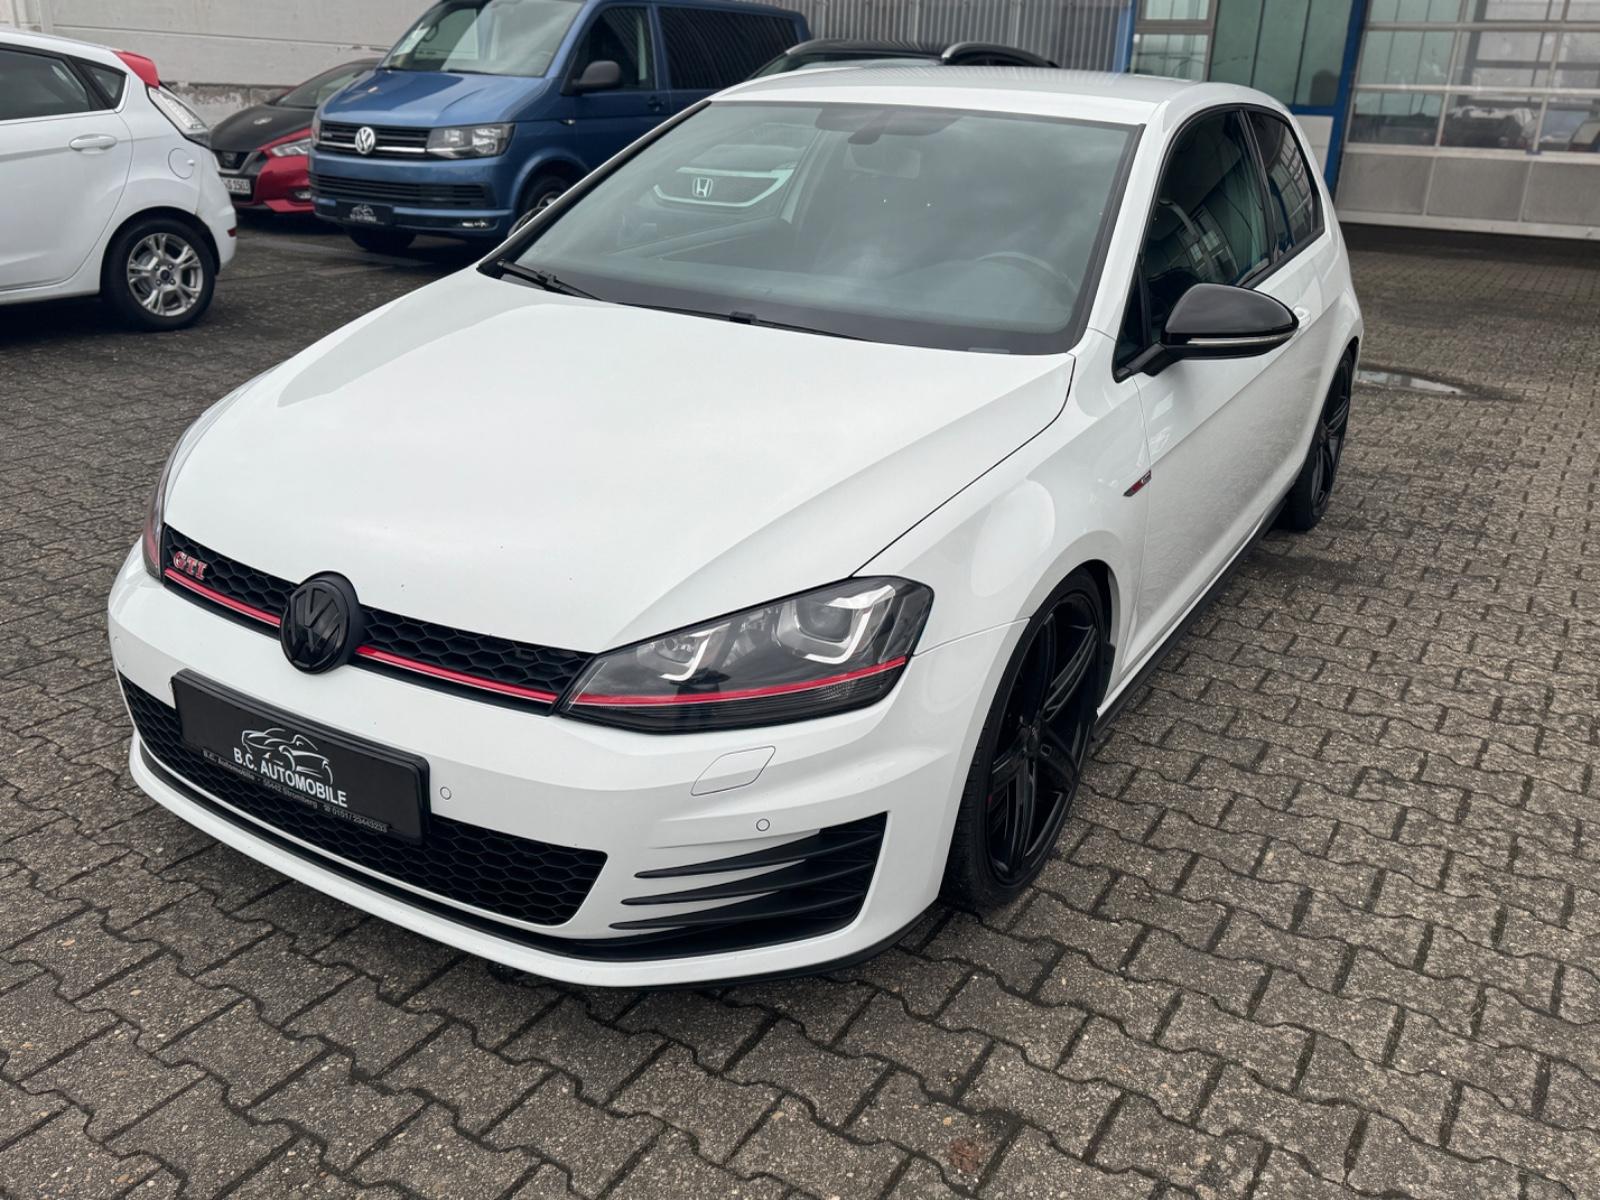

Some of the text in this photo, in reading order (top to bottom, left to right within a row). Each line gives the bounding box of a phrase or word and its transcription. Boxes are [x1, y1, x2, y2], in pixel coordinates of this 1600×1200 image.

[173, 550, 208, 580] GTI
[233, 747, 348, 807] B.C. AUTOMOBILE
